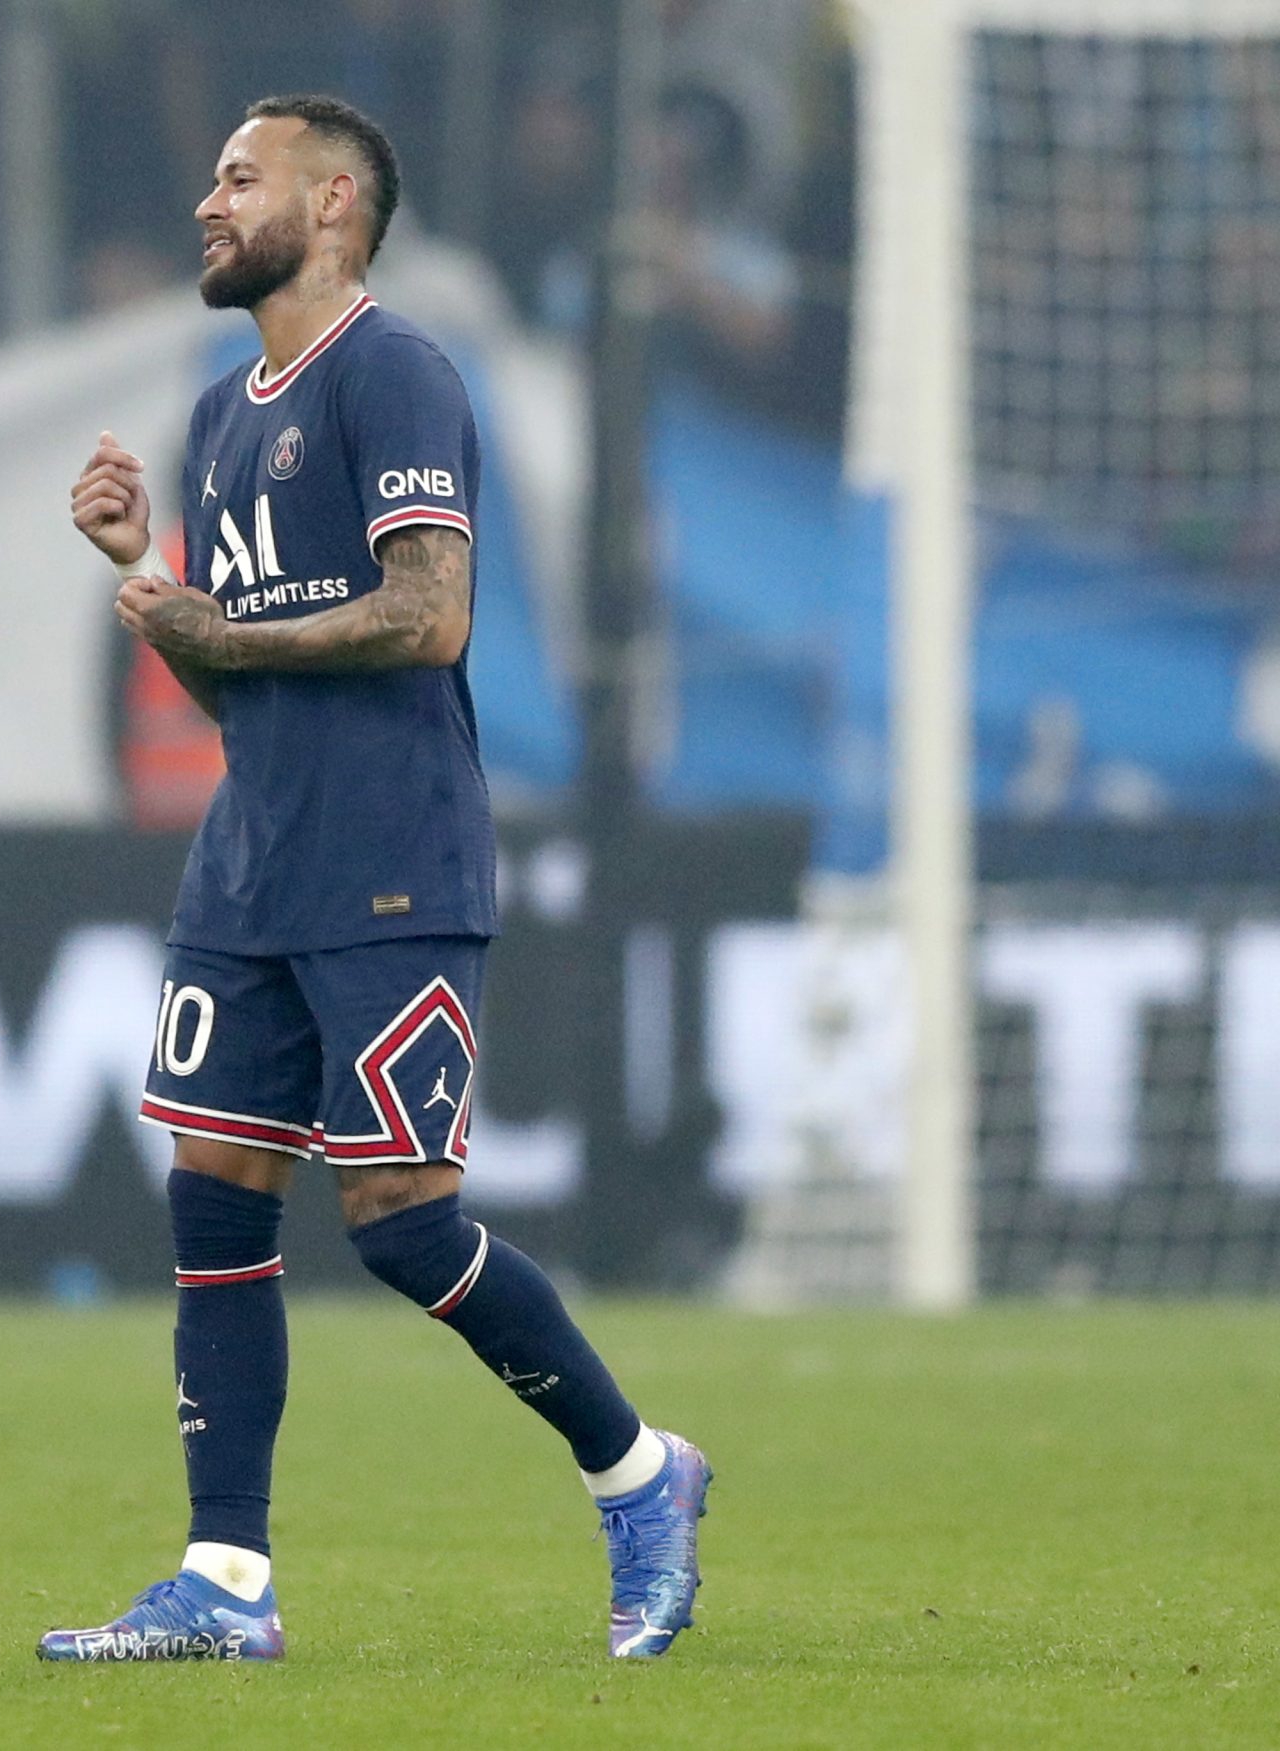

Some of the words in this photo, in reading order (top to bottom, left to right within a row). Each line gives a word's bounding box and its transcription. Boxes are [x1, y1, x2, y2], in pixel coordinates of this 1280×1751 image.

[378, 467, 455, 499] QNB
[263, 578, 349, 609] MITLESS
[156, 979, 215, 1076] 10
